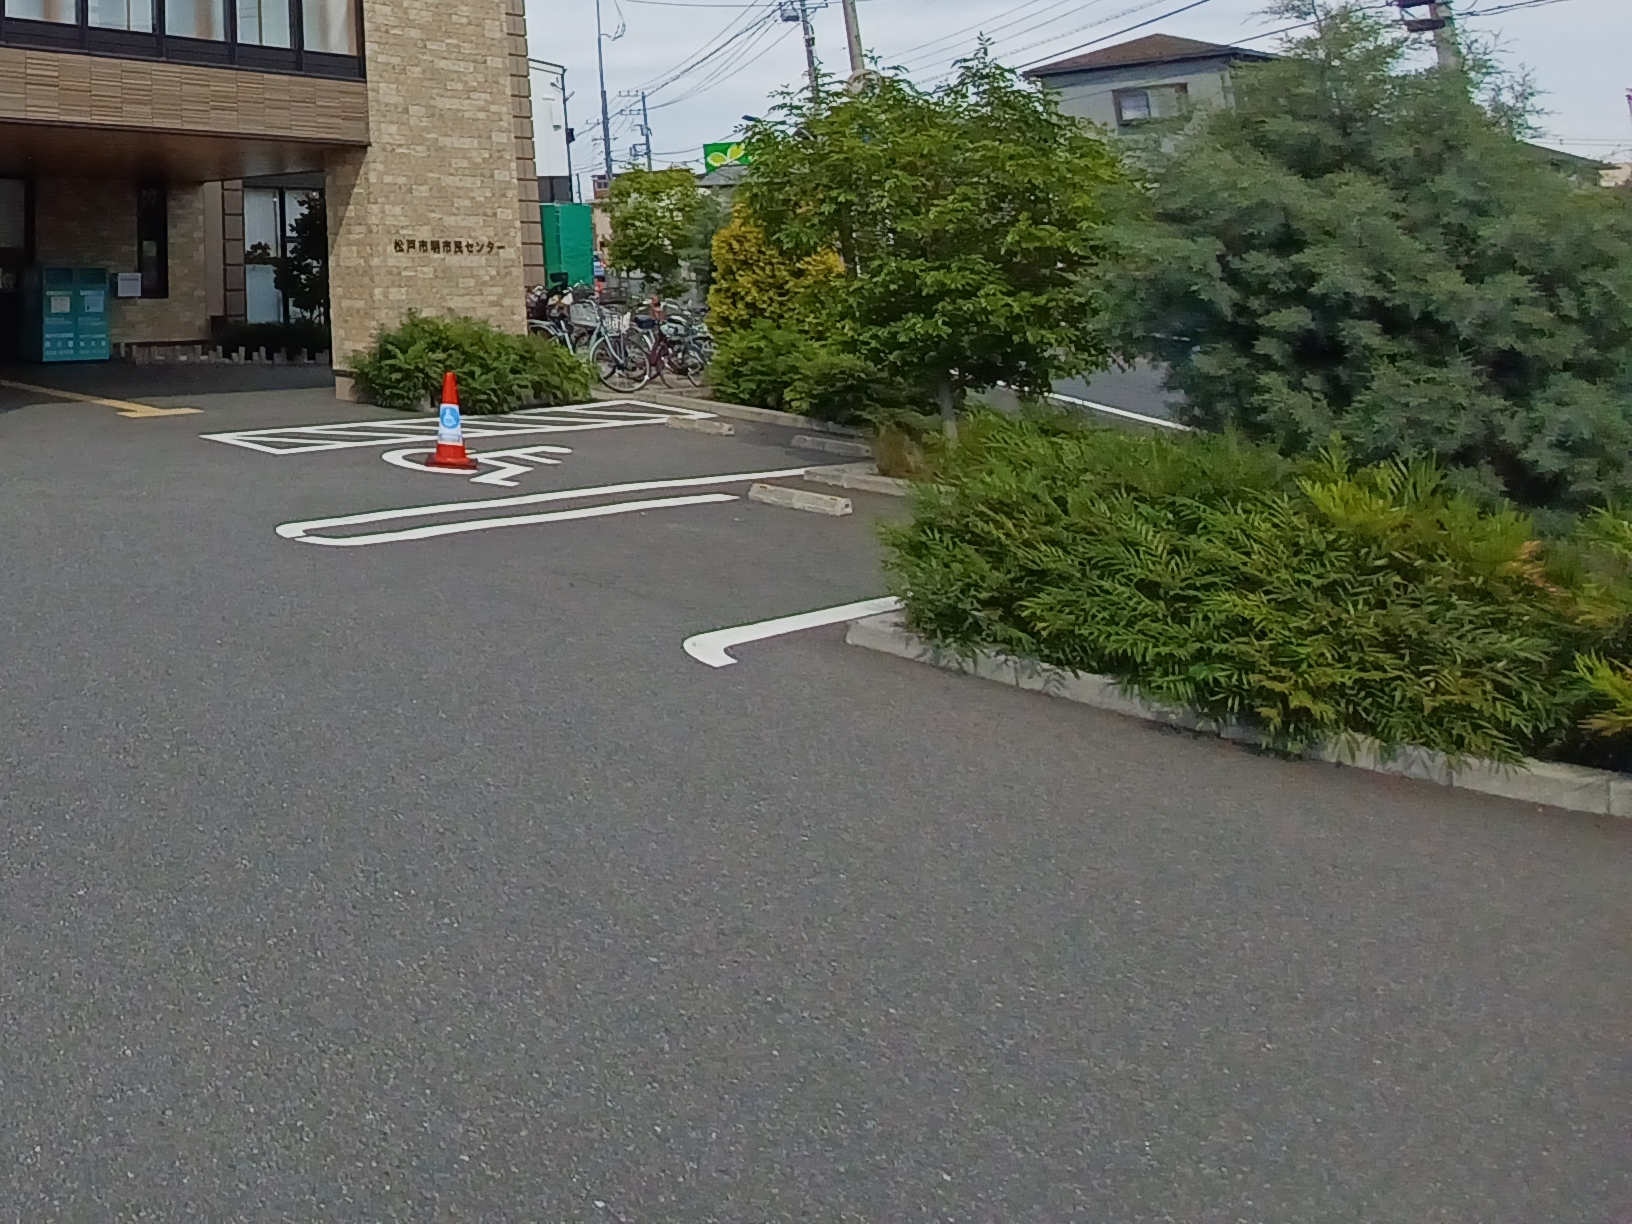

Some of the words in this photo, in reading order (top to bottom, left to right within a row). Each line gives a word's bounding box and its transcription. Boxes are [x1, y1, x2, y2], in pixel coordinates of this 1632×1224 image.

[393, 239, 506, 254] 松戸市明市民センター
